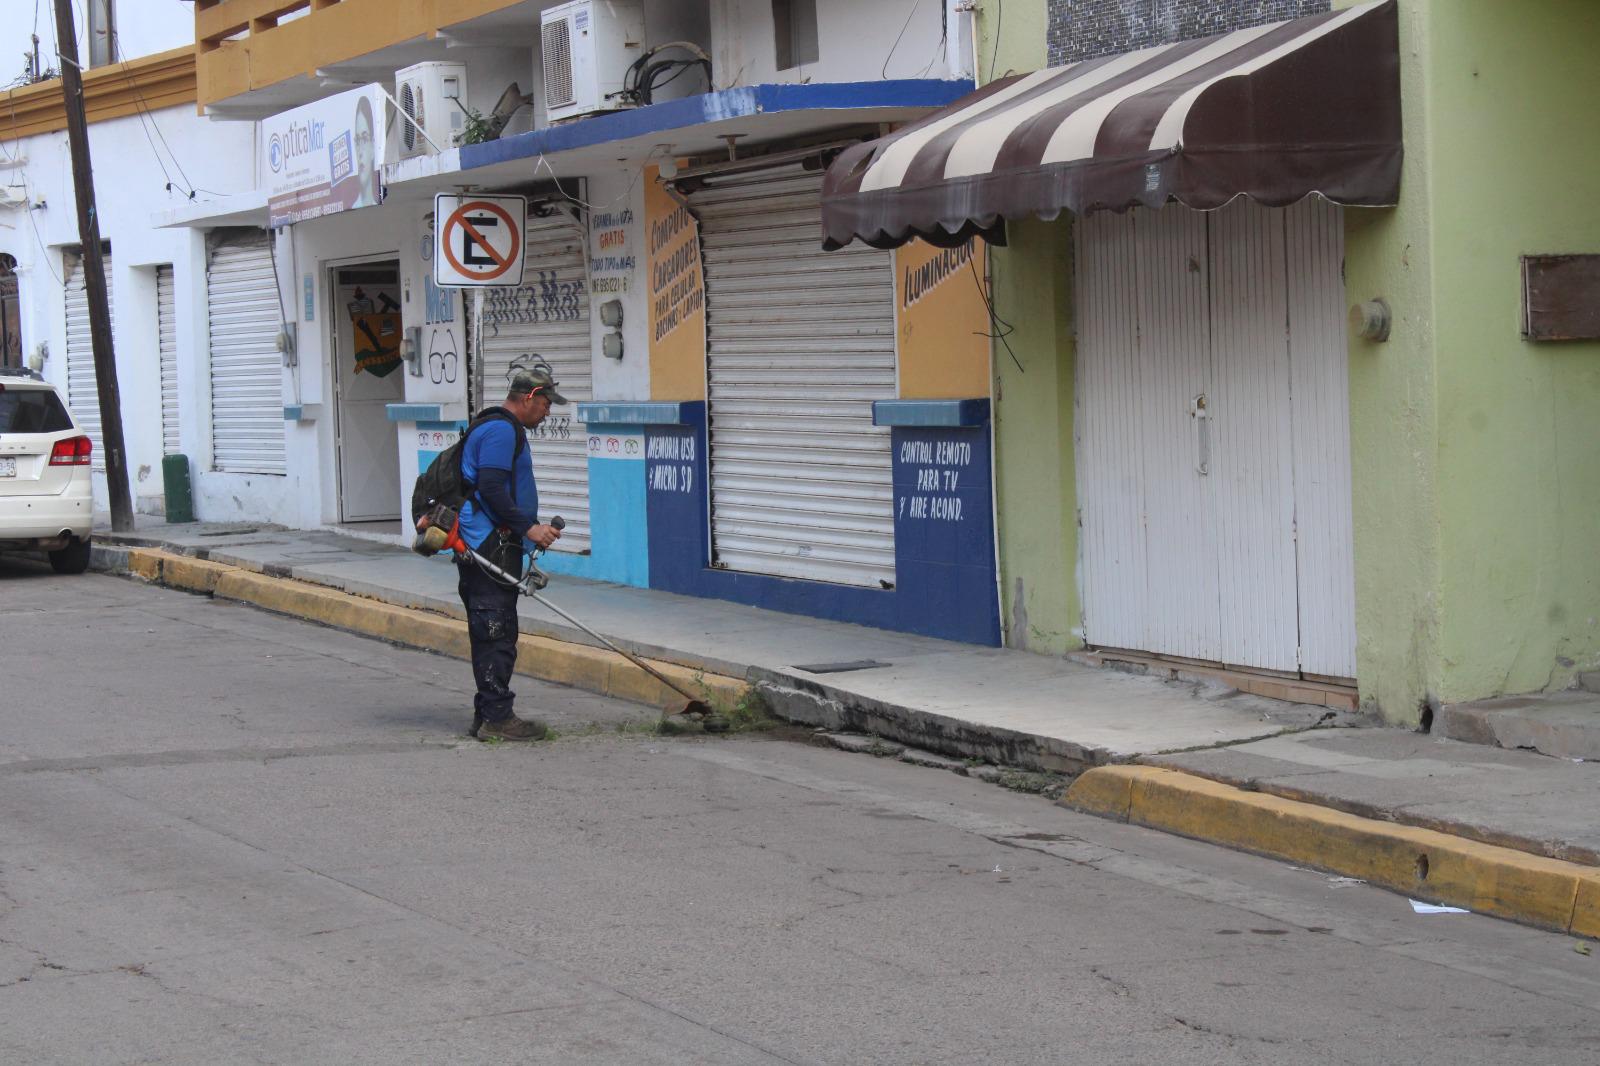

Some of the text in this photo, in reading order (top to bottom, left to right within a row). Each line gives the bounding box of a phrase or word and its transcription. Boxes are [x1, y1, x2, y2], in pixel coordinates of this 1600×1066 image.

[463, 217, 499, 265] E
[600, 229, 625, 249] GRATIS
[653, 235, 698, 295] CARGADORES
[483, 270, 584, 337] ptica Mar
[655, 269, 695, 321] PARA CELULAR
[656, 306, 678, 342] BOCINAS
[683, 287, 703, 319] LAPTOP
[648, 436, 695, 461] MEMORIA USB
[900, 441, 971, 467] CONTROL REMOTO
[654, 464, 677, 491] MICRO
[917, 468, 959, 492] PARA TV
[909, 496, 928, 519] AIRE
[930, 496, 963, 520] ACOND.
